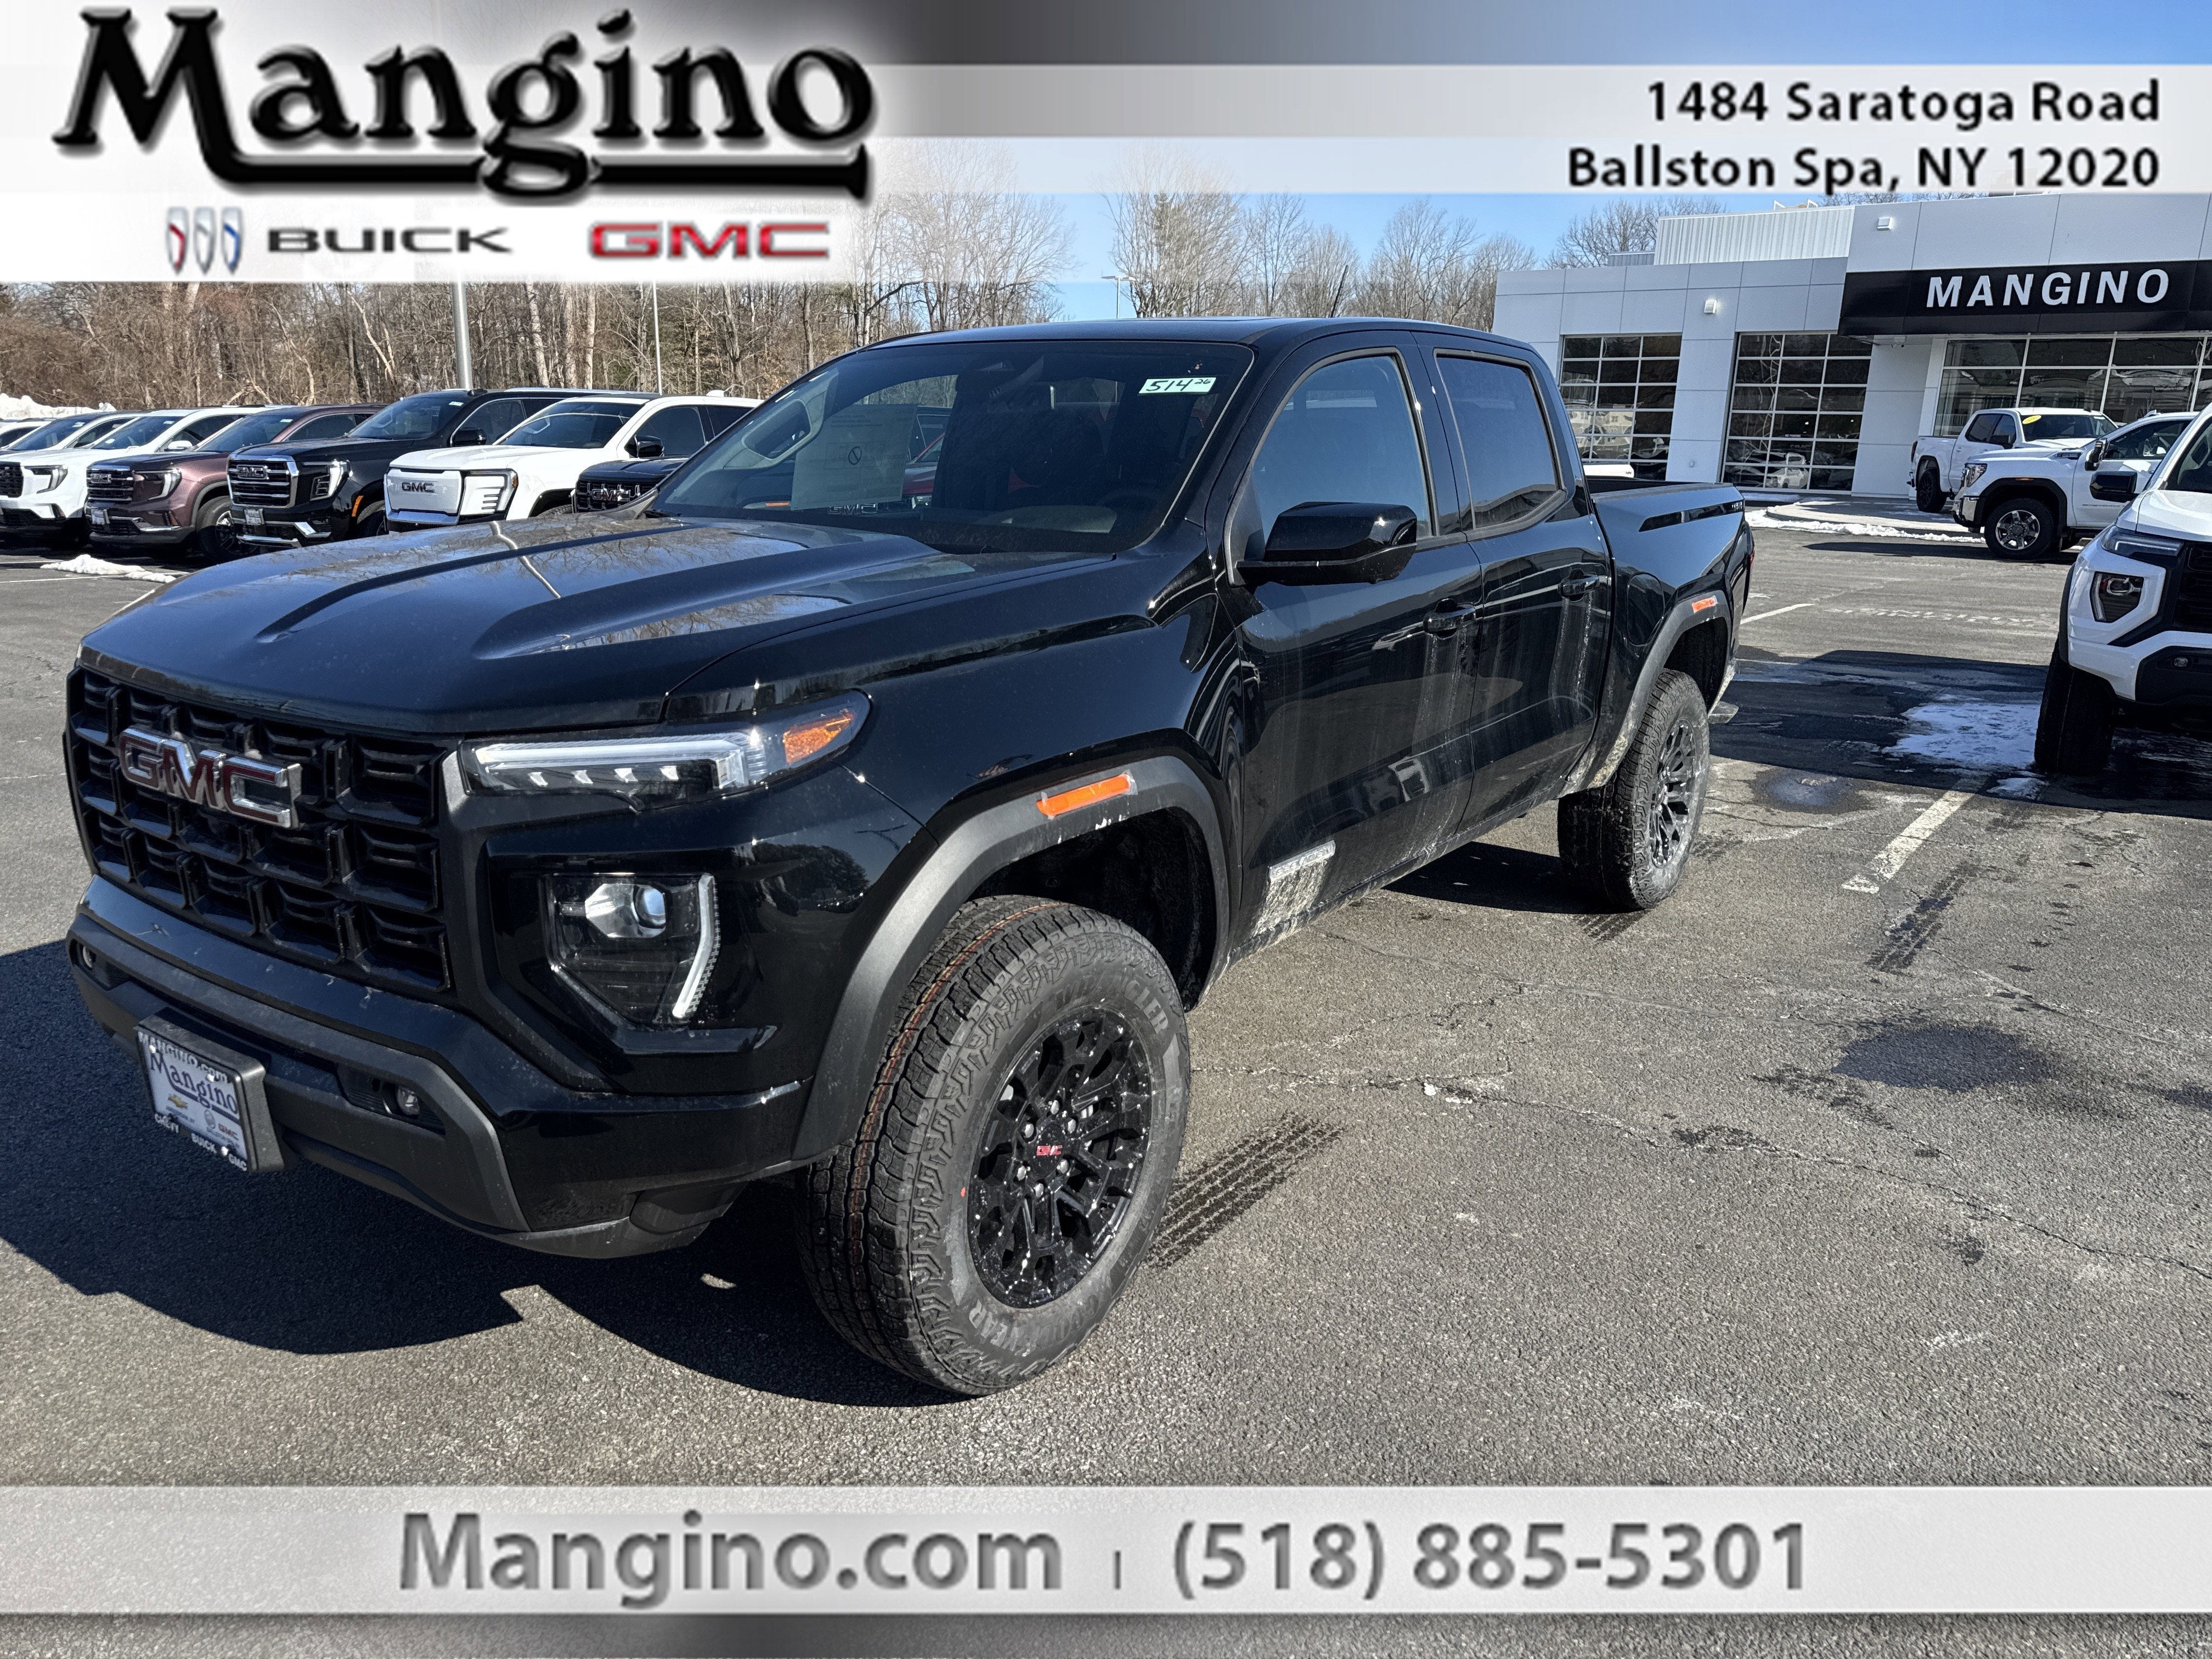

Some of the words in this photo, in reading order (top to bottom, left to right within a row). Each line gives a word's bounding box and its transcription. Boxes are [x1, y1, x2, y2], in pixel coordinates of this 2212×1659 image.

[1926, 269, 2169, 308] MANGINO
[1146, 379, 1194, 392] 514
[402, 482, 435, 493] GMC
[592, 488, 631, 503] GMC
[828, 503, 878, 516] GMC
[119, 727, 299, 827] GMC
[150, 1050, 240, 1116] Mangino
